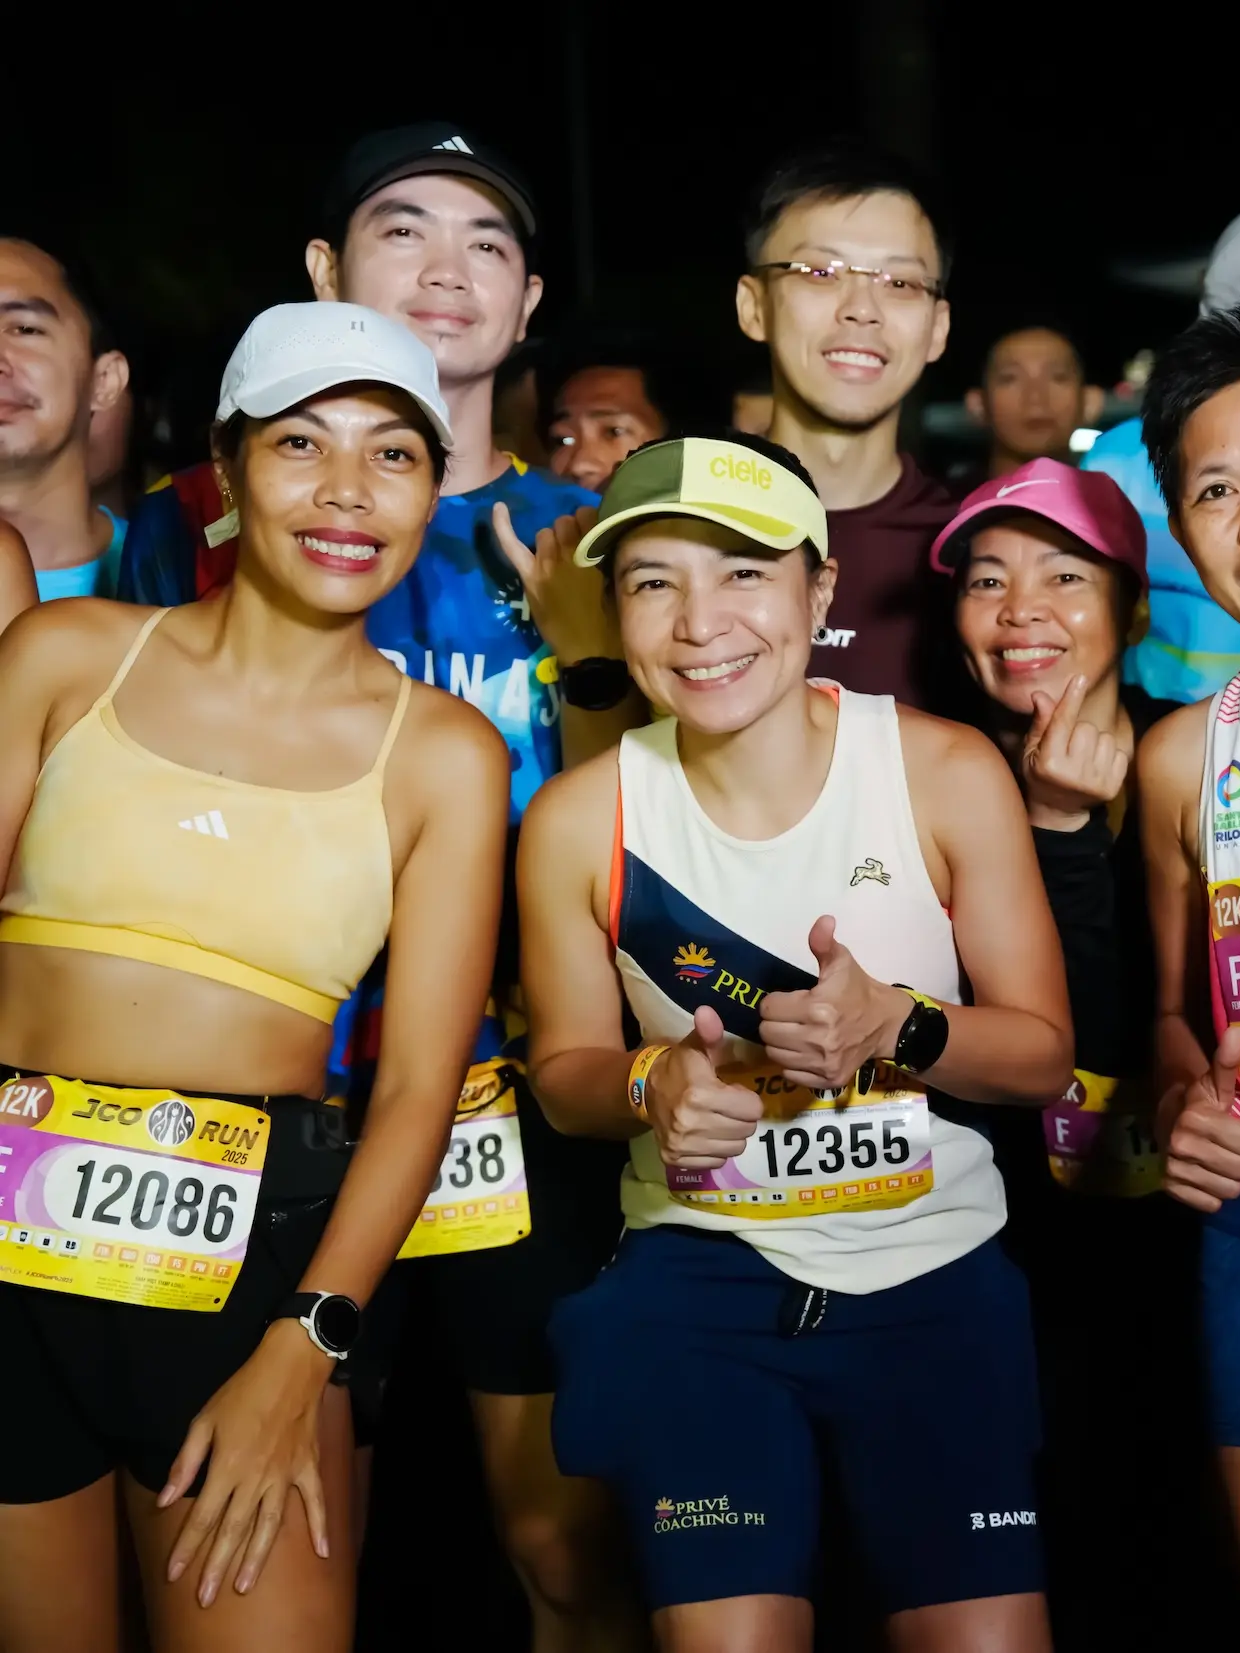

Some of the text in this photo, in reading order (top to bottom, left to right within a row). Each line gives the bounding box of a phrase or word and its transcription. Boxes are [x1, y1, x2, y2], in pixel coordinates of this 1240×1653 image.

[709, 454, 772, 489] ciele
[711, 968, 769, 1010] PRI
[0, 1085, 47, 1118] 12K
[633, 1085, 641, 1104] VIP
[72, 1098, 260, 1150] JCO RUN
[1054, 1116, 1070, 1144] F
[221, 1149, 248, 1165] 2025
[429, 1132, 505, 1193] 38
[759, 1119, 910, 1178] 12355
[676, 1175, 703, 1184] FEMALE
[72, 1160, 238, 1243] 12086
[676, 1495, 730, 1515] PRIVÉ
[989, 1511, 1037, 1527] BANDIT
[654, 1512, 765, 1533] COACHING PH
